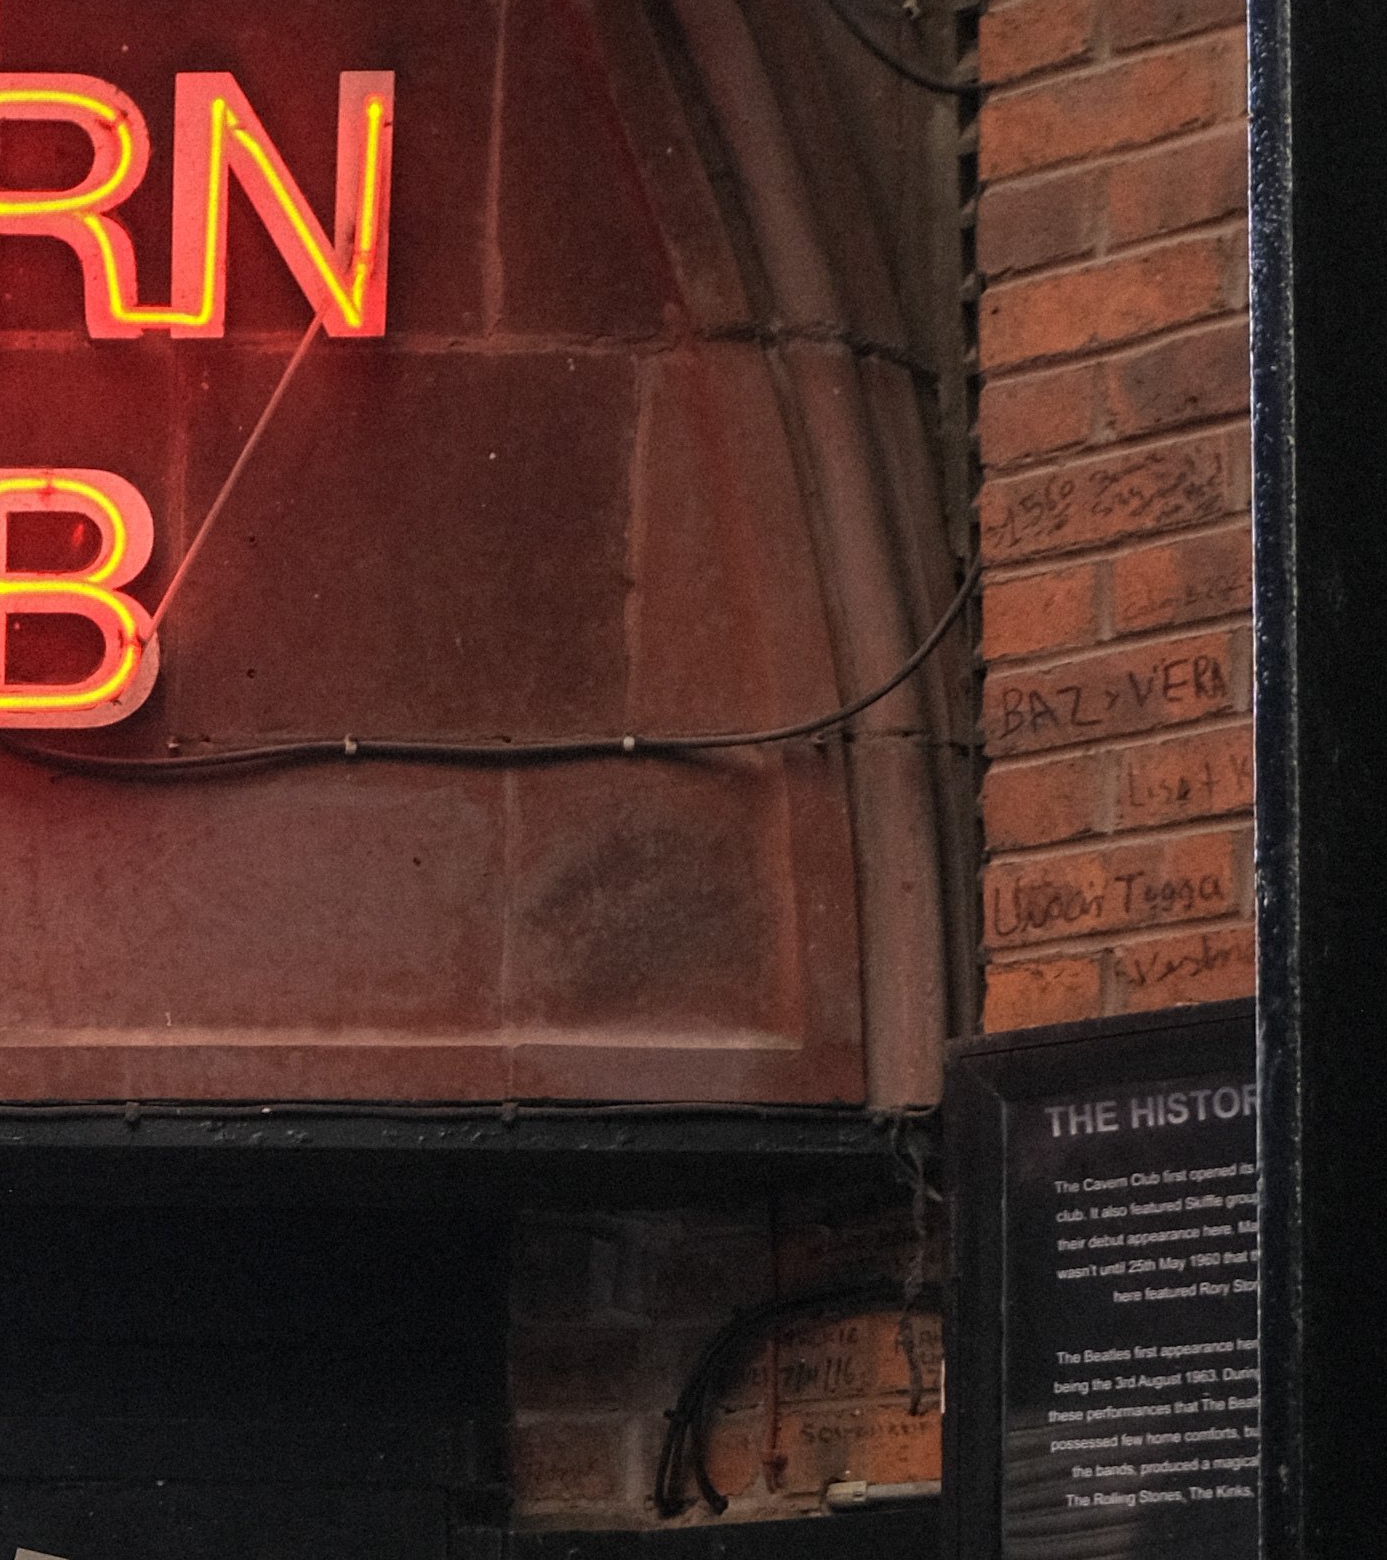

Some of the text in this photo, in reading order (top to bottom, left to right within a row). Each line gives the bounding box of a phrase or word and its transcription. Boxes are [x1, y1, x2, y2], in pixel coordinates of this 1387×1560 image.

[1044, 1101, 1119, 1137] THE
[1055, 1163, 1236, 1193] The Cavern Club opened
[1130, 1198, 1182, 1215] featured
[1127, 1228, 1200, 1247] appearance
[1159, 1257, 1186, 1272] May
[1145, 1282, 1230, 1300] featured Rory
[1057, 1340, 1234, 1364] The Beatles first appearance
[1054, 1373, 1182, 1394] being the August
[1048, 1410, 1083, 1423] these
[1086, 1403, 1171, 1423] performances
[1202, 1398, 1226, 1411] The
[1051, 1432, 1181, 1453] possessed home
[1072, 1458, 1199, 1478] the produced
[1065, 1487, 1213, 1507] The Rolling The
